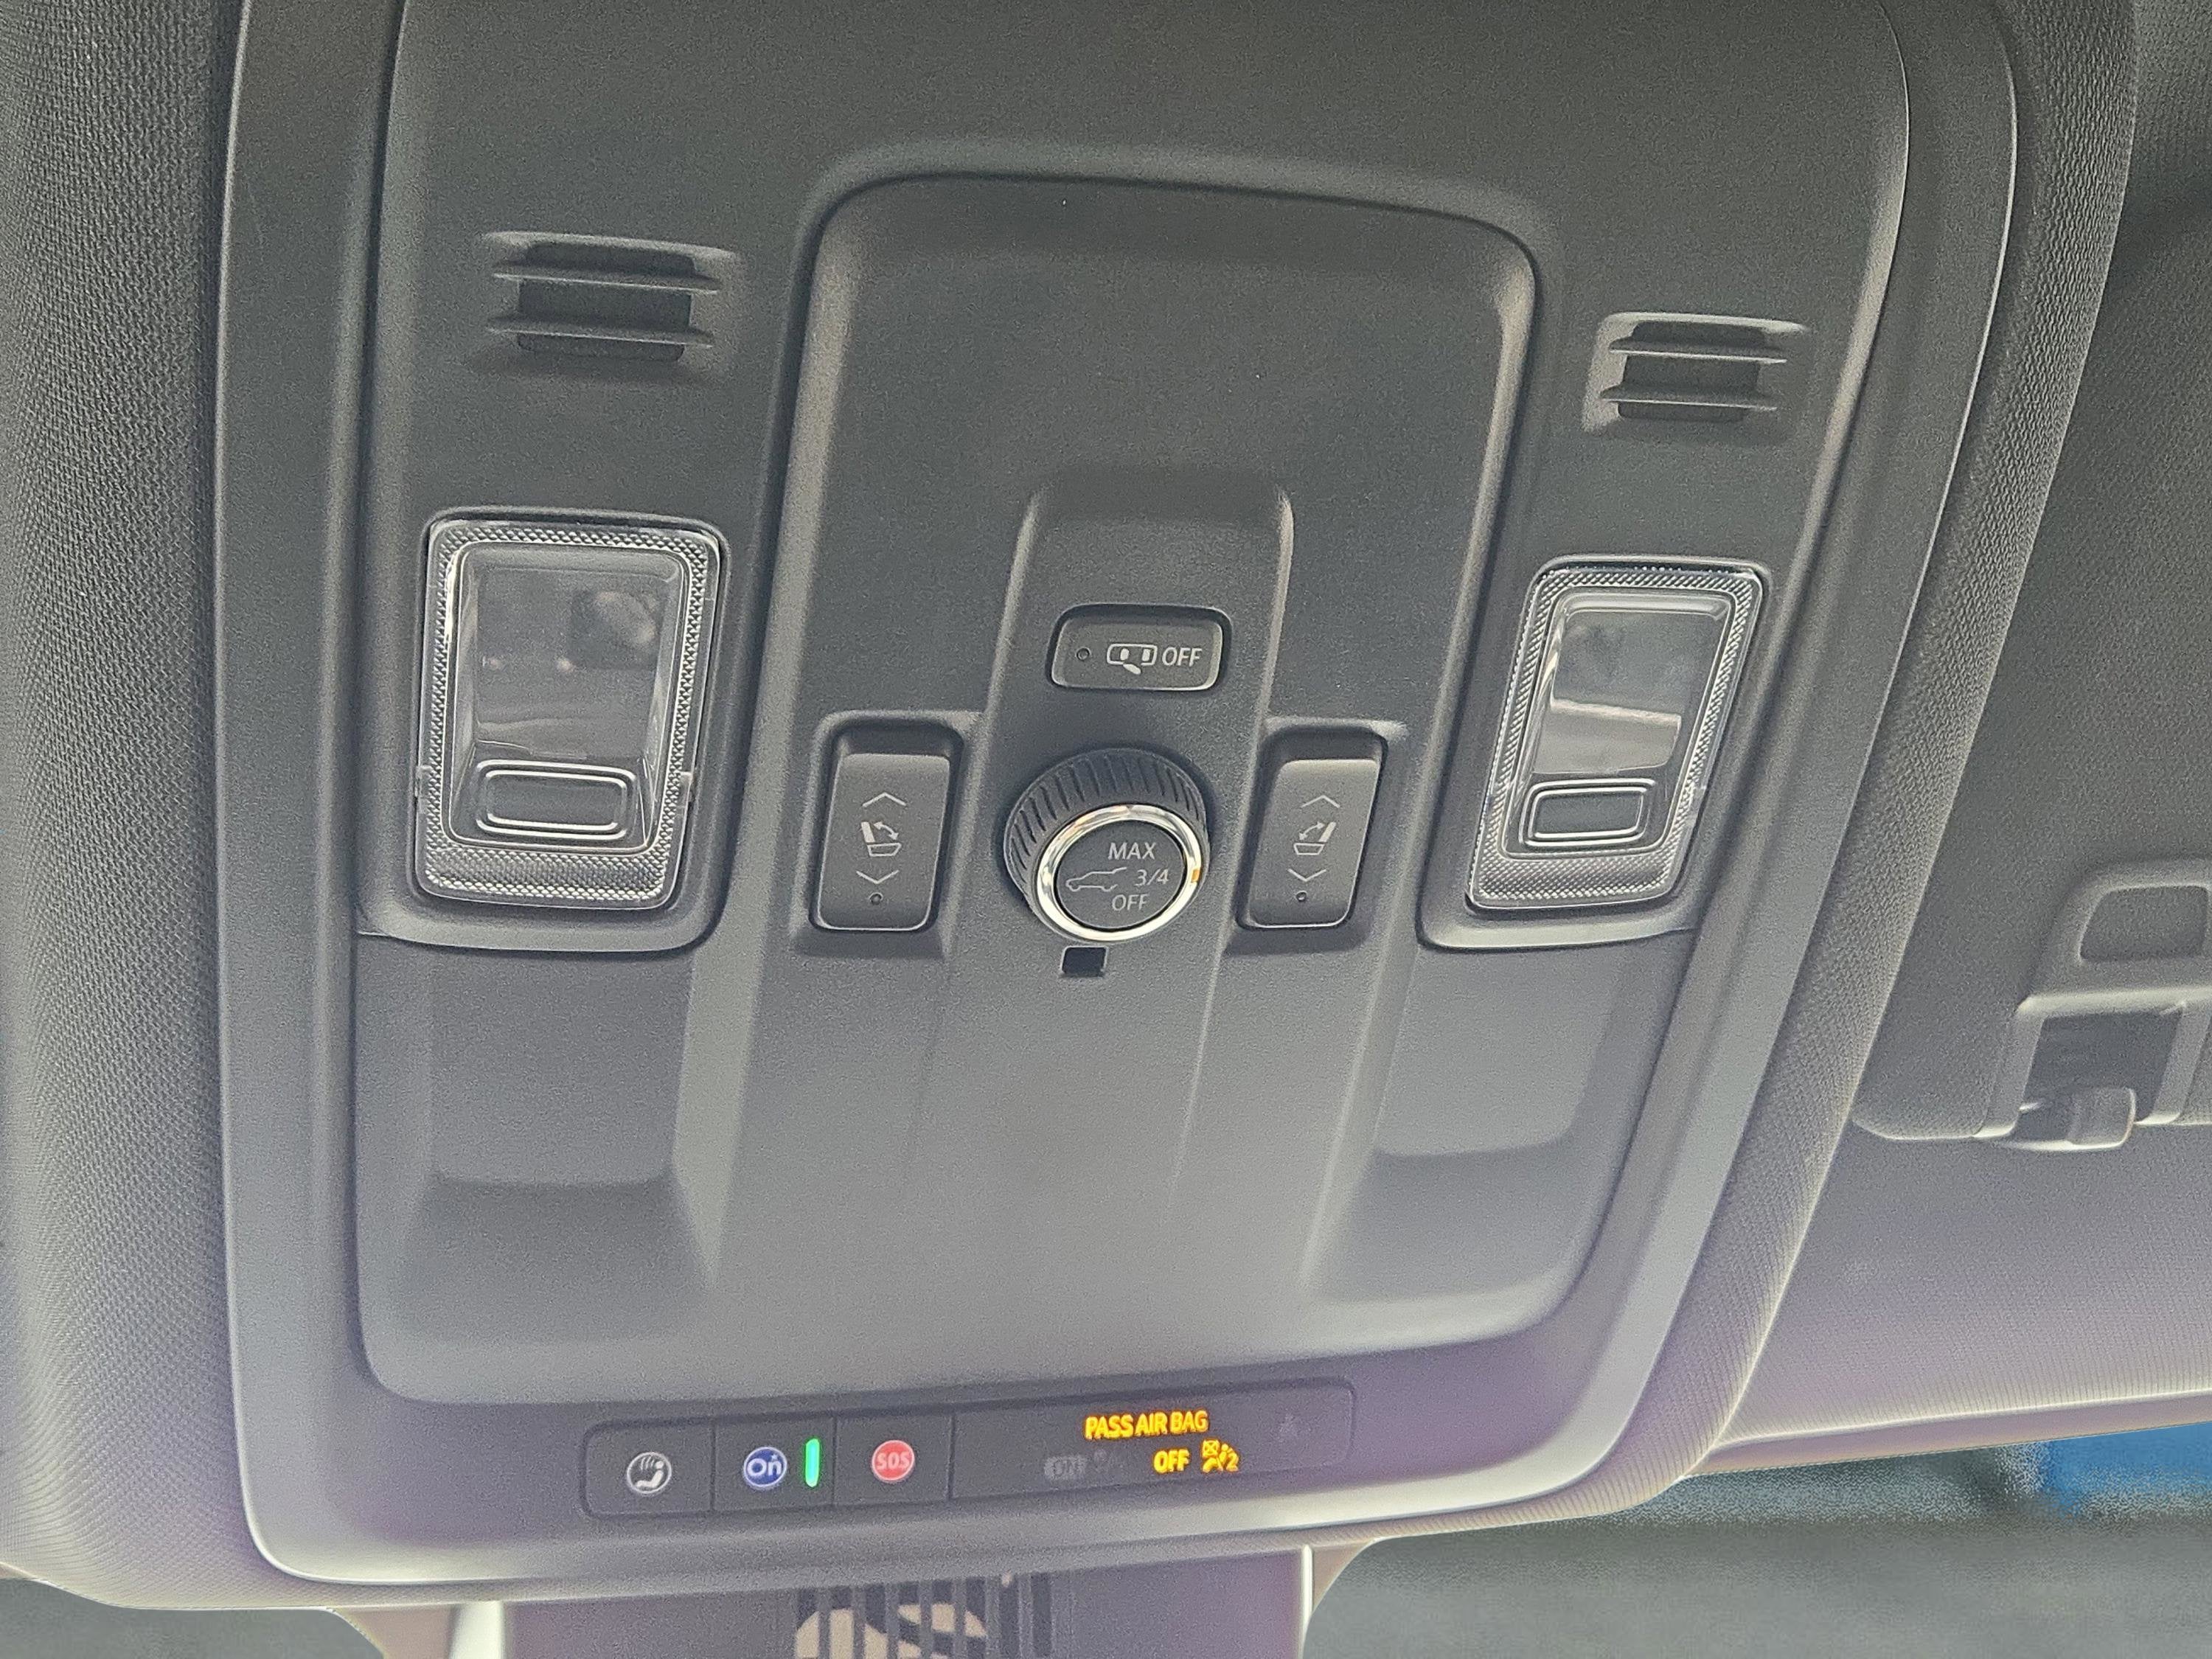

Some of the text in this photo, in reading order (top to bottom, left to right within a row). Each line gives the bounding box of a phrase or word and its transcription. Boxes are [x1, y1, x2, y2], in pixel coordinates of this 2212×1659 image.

[1161, 646, 1203, 667] OFF
[1107, 842, 1156, 860] MAX
[1135, 869, 1169, 886] 3/4
[1111, 894, 1149, 911] OFF
[1085, 1410, 1208, 1439] PASS AIR BAG
[874, 1451, 911, 1471] SOS
[1153, 1447, 1190, 1473] OFF
